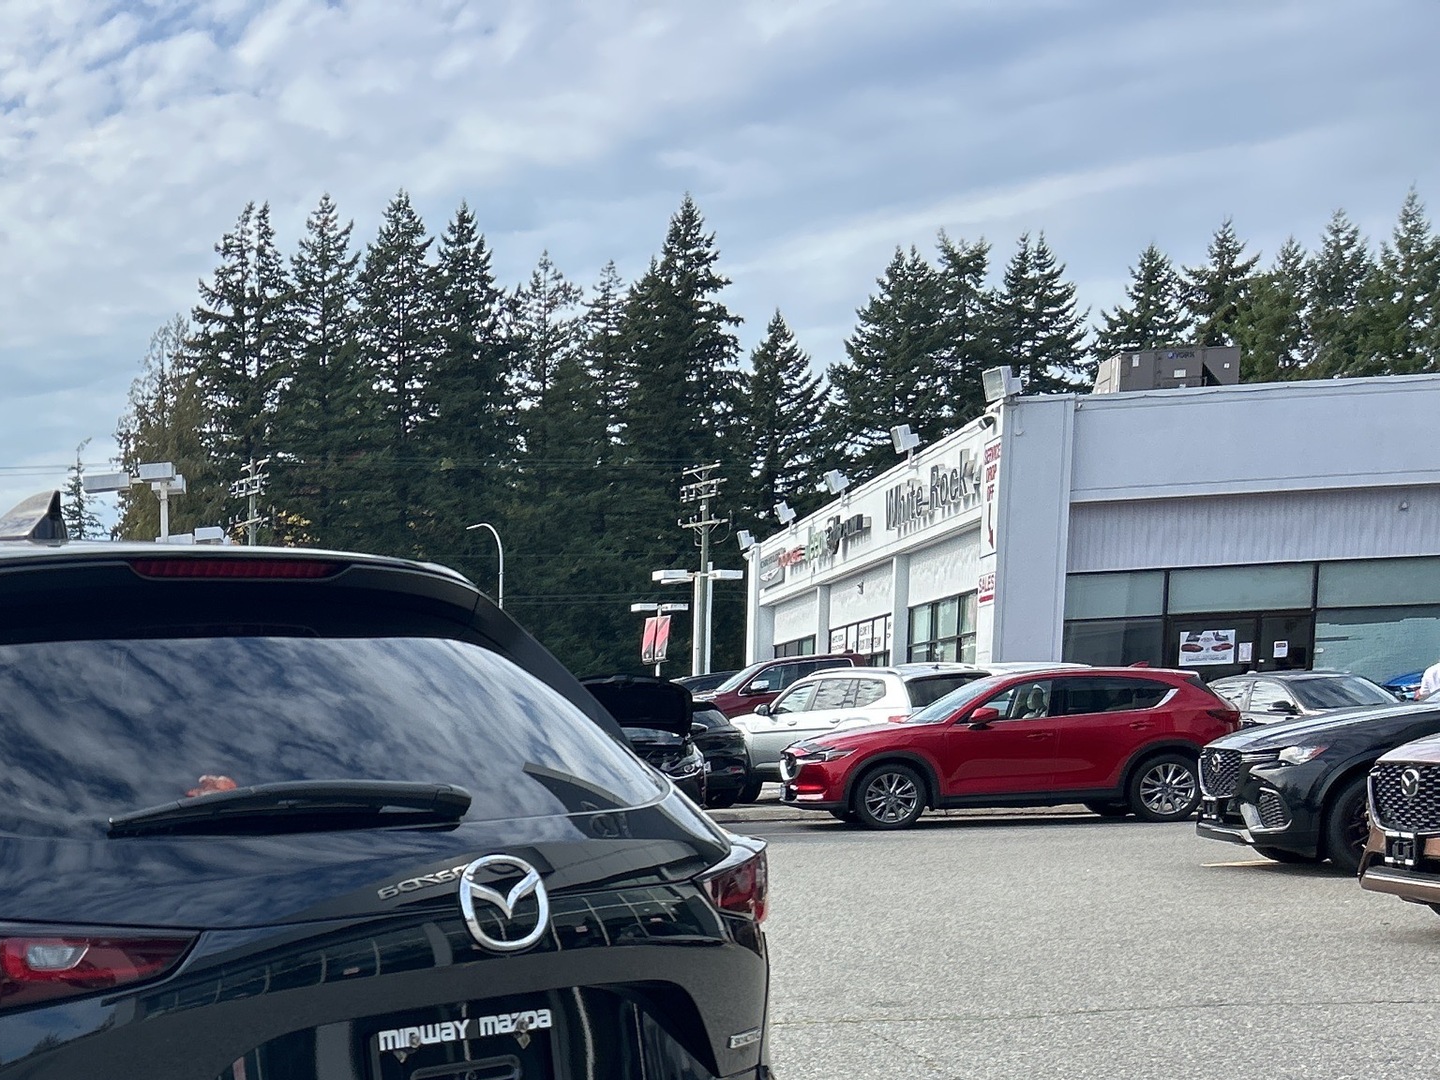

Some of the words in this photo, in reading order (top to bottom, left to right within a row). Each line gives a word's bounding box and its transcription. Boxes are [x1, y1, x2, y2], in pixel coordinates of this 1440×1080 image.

[984, 443, 1001, 465] SERVICE
[986, 463, 997, 484] DROP
[885, 479, 924, 531] White
[928, 449, 969, 511] Rock
[986, 484, 995, 502] OFF
[978, 574, 995, 594] SALES
